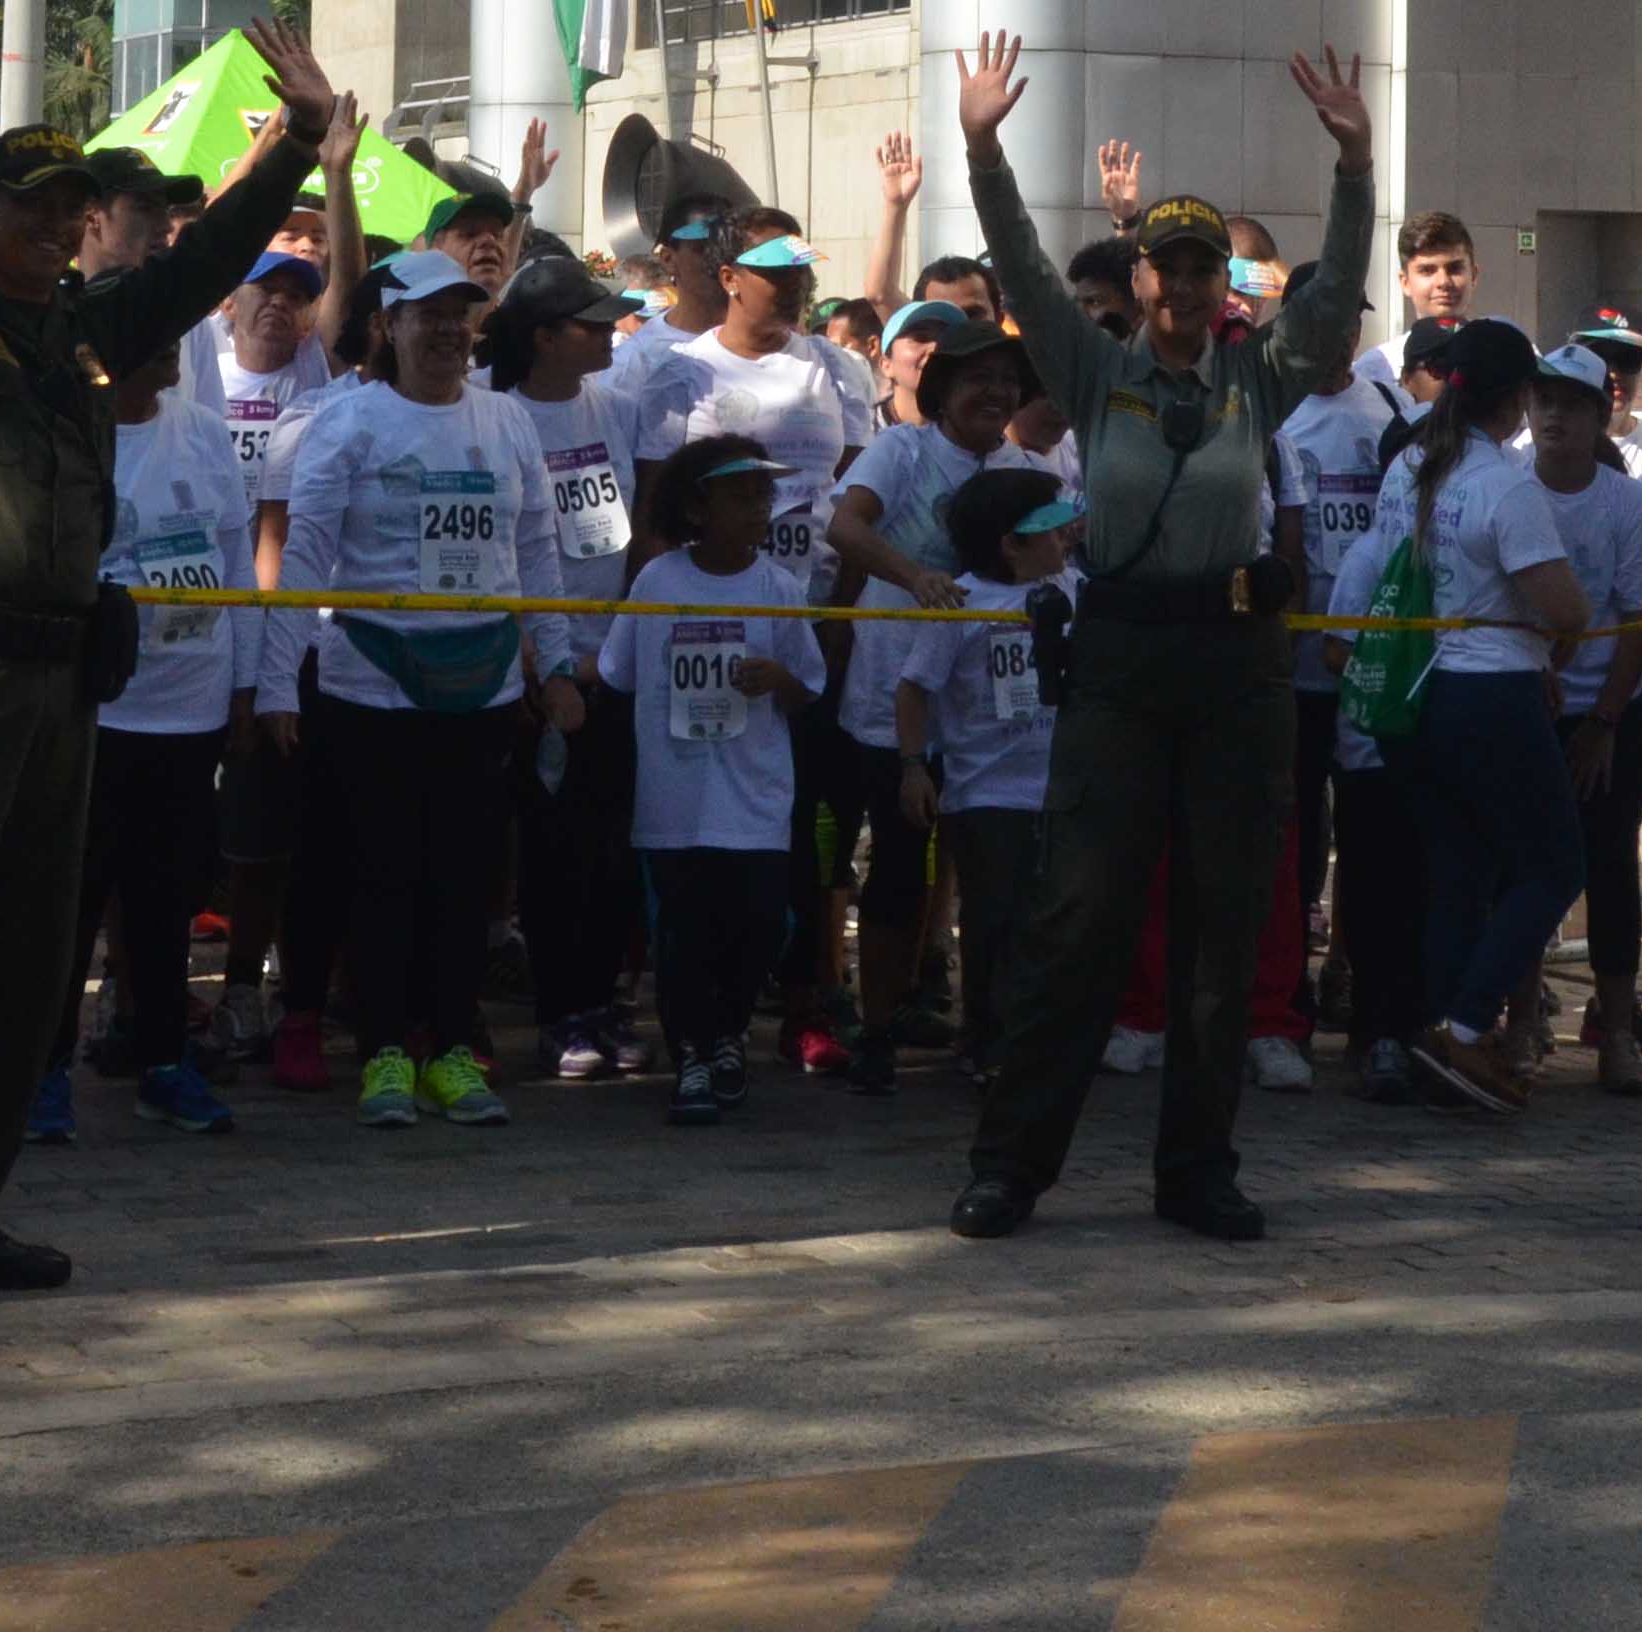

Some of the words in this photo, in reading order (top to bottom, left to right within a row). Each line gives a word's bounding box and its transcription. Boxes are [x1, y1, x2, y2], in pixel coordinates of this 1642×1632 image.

[555, 471, 618, 515] 0505
[423, 504, 494, 541] 2496
[1322, 501, 1376, 533] 039
[994, 643, 1036, 679] 08
